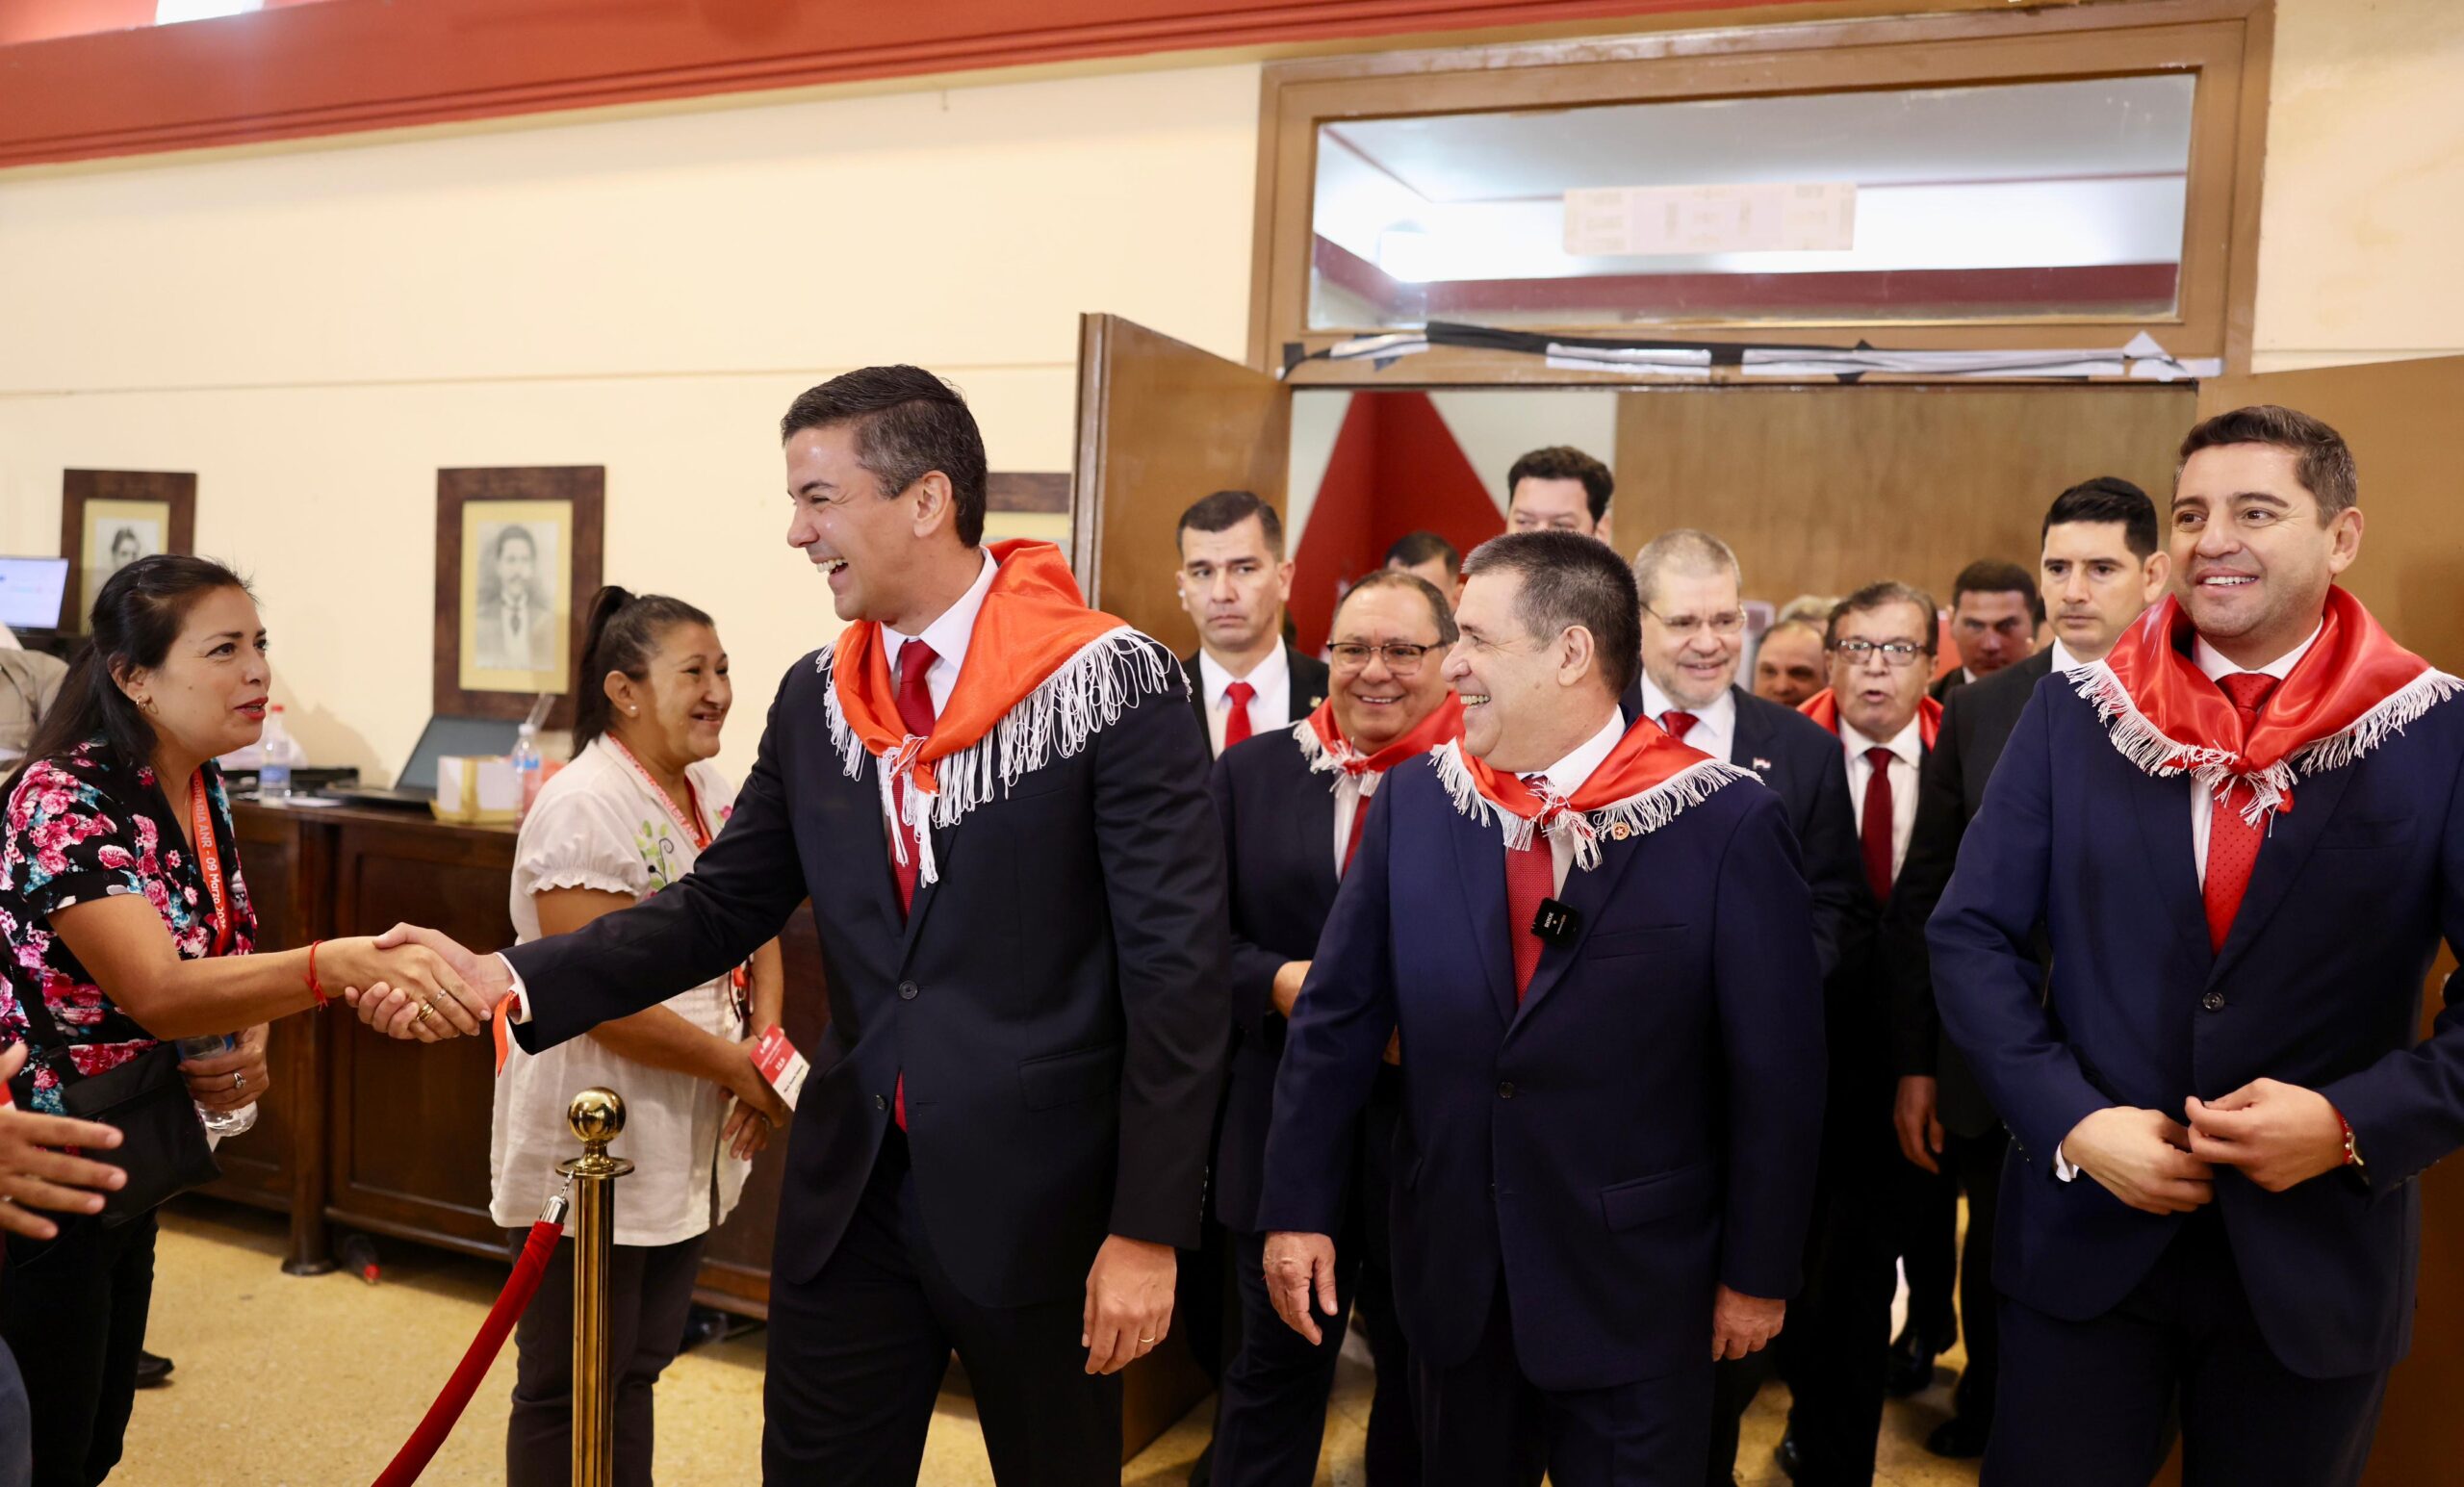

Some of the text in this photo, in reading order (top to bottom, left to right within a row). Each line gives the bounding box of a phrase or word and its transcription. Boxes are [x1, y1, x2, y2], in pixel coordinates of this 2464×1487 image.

[193, 771, 207, 822] RDINARIA
[199, 825, 213, 848] ANR
[206, 857, 218, 871] 09
[209, 873, 220, 905] Marzo
